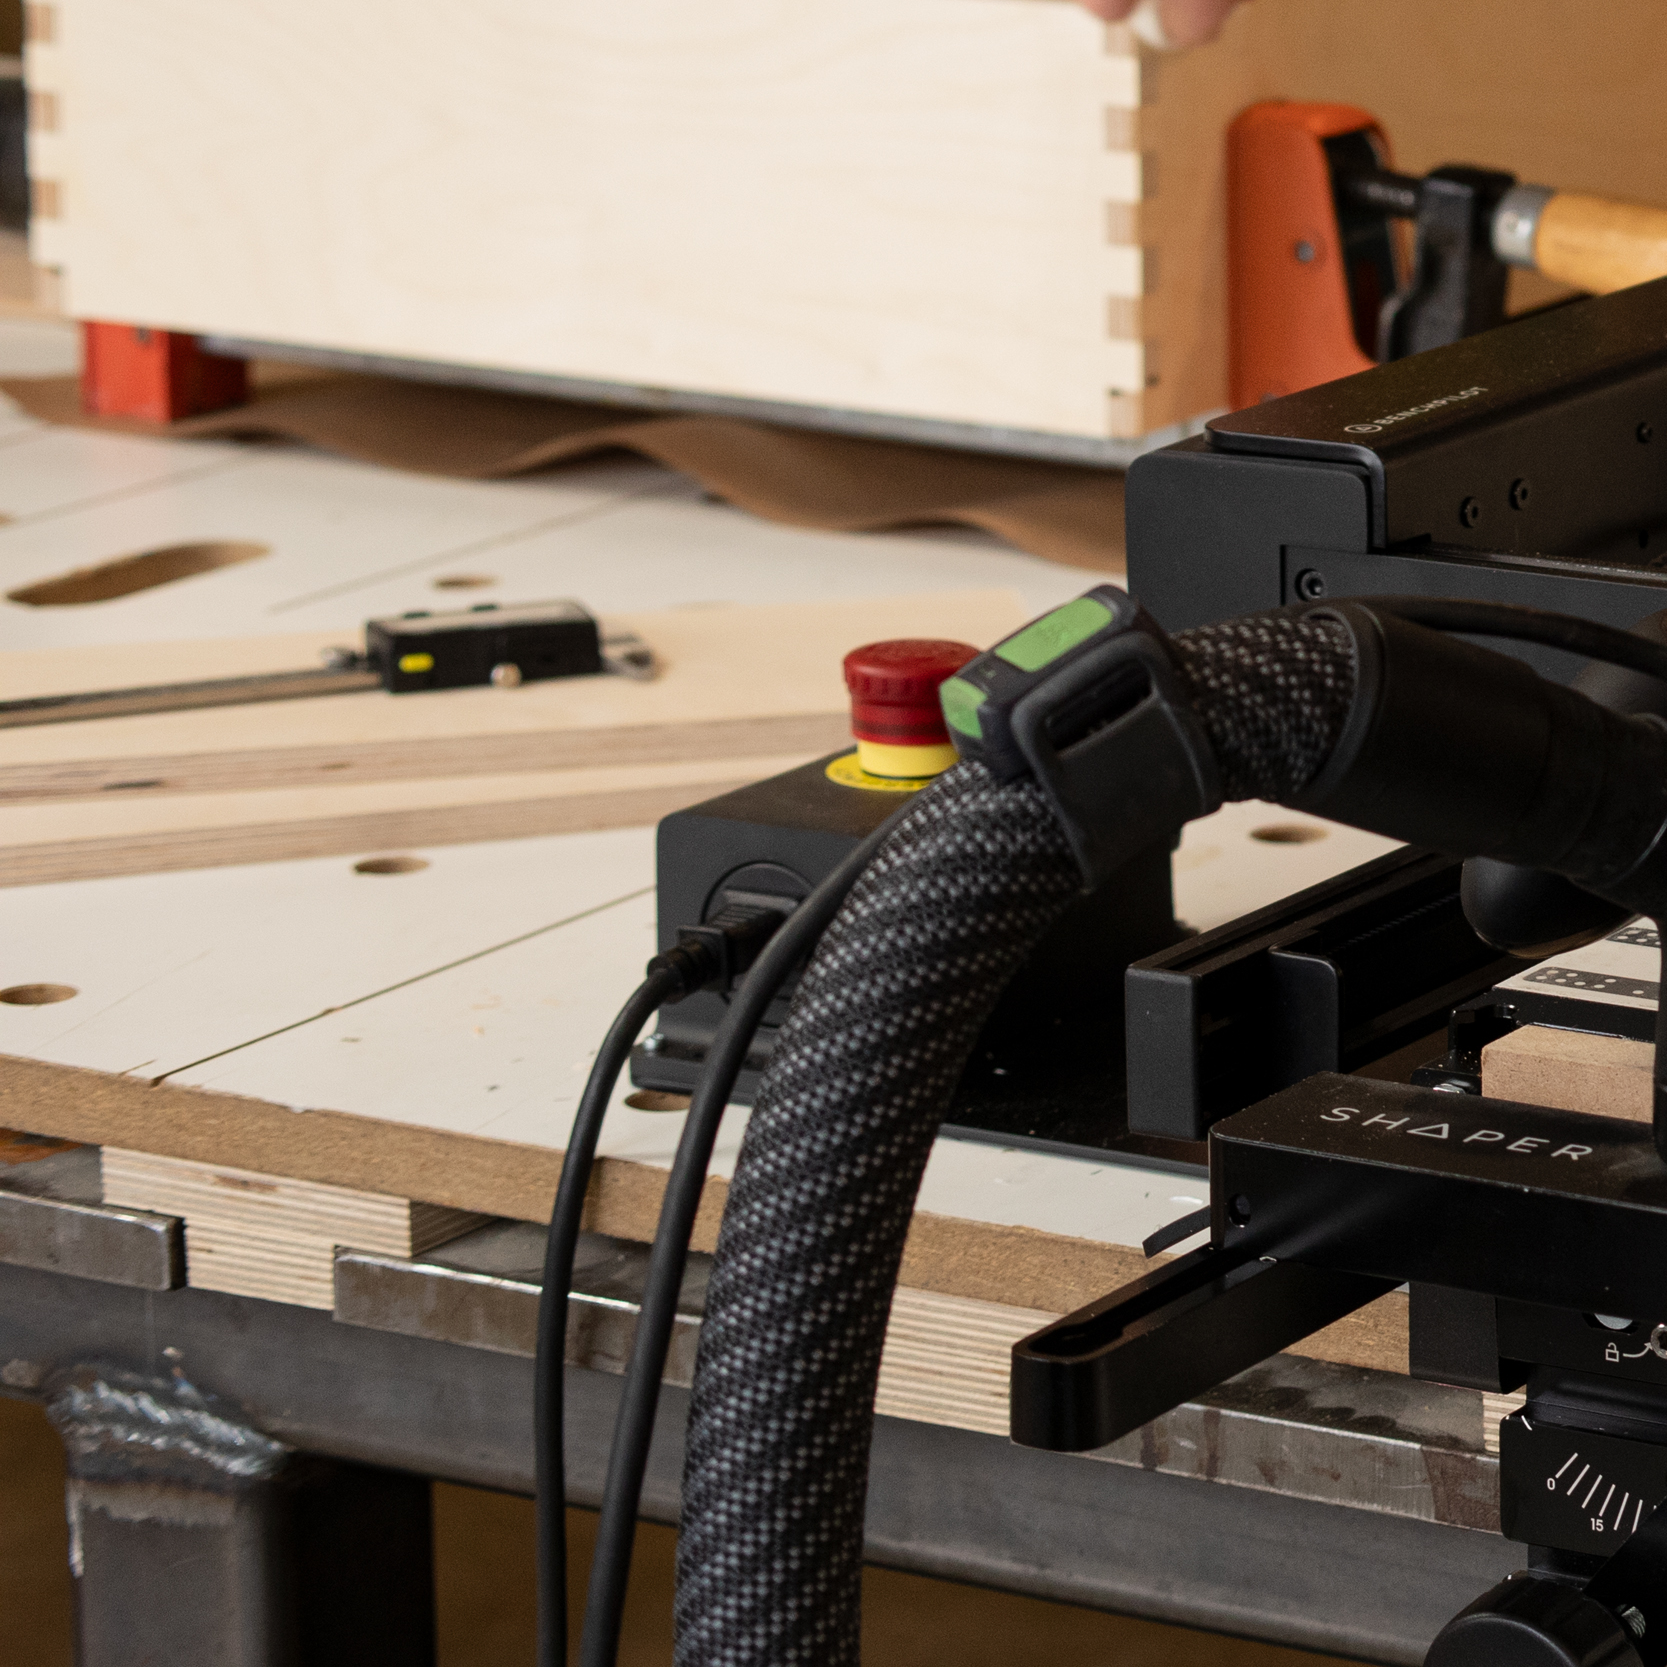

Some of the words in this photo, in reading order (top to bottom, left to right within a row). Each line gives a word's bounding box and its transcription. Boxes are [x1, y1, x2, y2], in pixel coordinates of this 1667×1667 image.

[1373, 386, 1489, 425] BENCHPILOT
[1320, 1107, 1593, 1161] SHAPER
[1546, 1477, 1556, 1491] 0
[1590, 1517, 1604, 1532] 15
